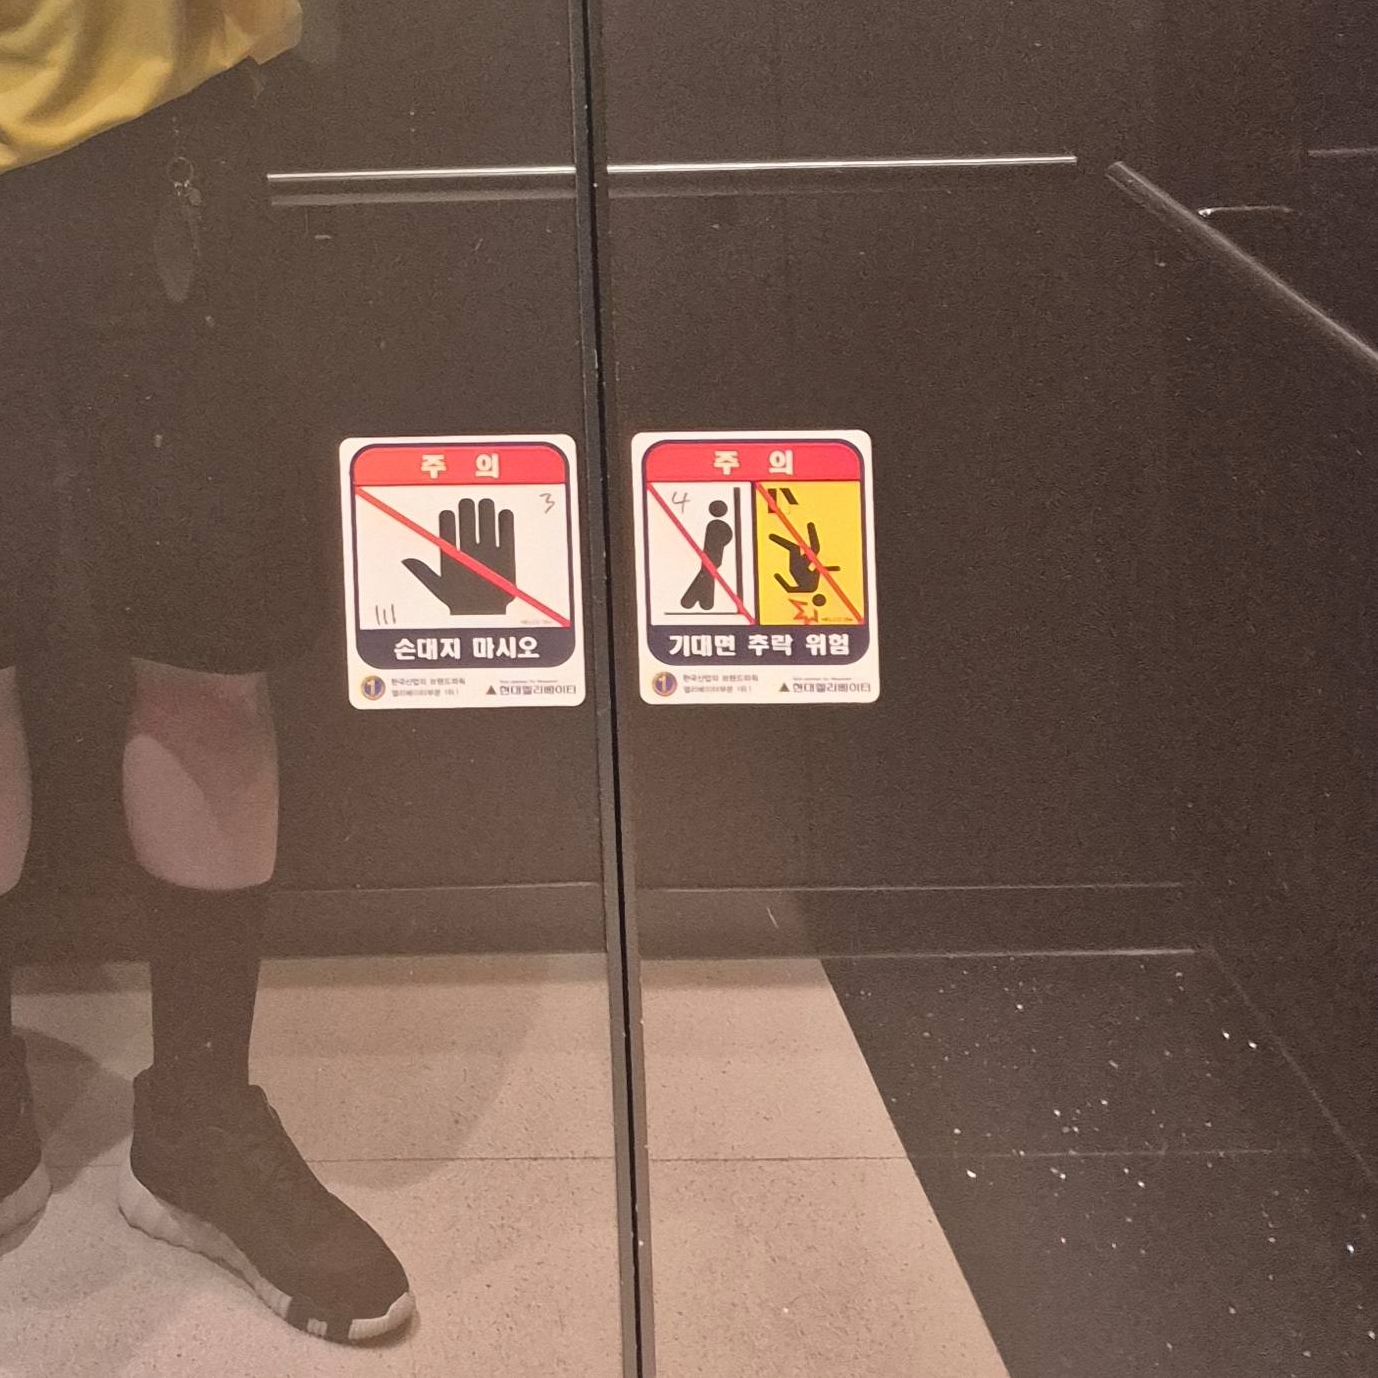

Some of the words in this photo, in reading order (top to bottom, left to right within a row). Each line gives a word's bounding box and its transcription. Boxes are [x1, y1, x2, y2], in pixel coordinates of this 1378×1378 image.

[671, 491, 691, 514] 4
[393, 637, 461, 661] 손대지
[472, 636, 540, 660] 마시오
[669, 633, 737, 657] 기대면
[747, 633, 794, 656] 추락
[805, 632, 850, 656] 위험
[499, 684, 577, 696] 현대엘리베이터
[792, 682, 871, 693] 현대엘리베이터
